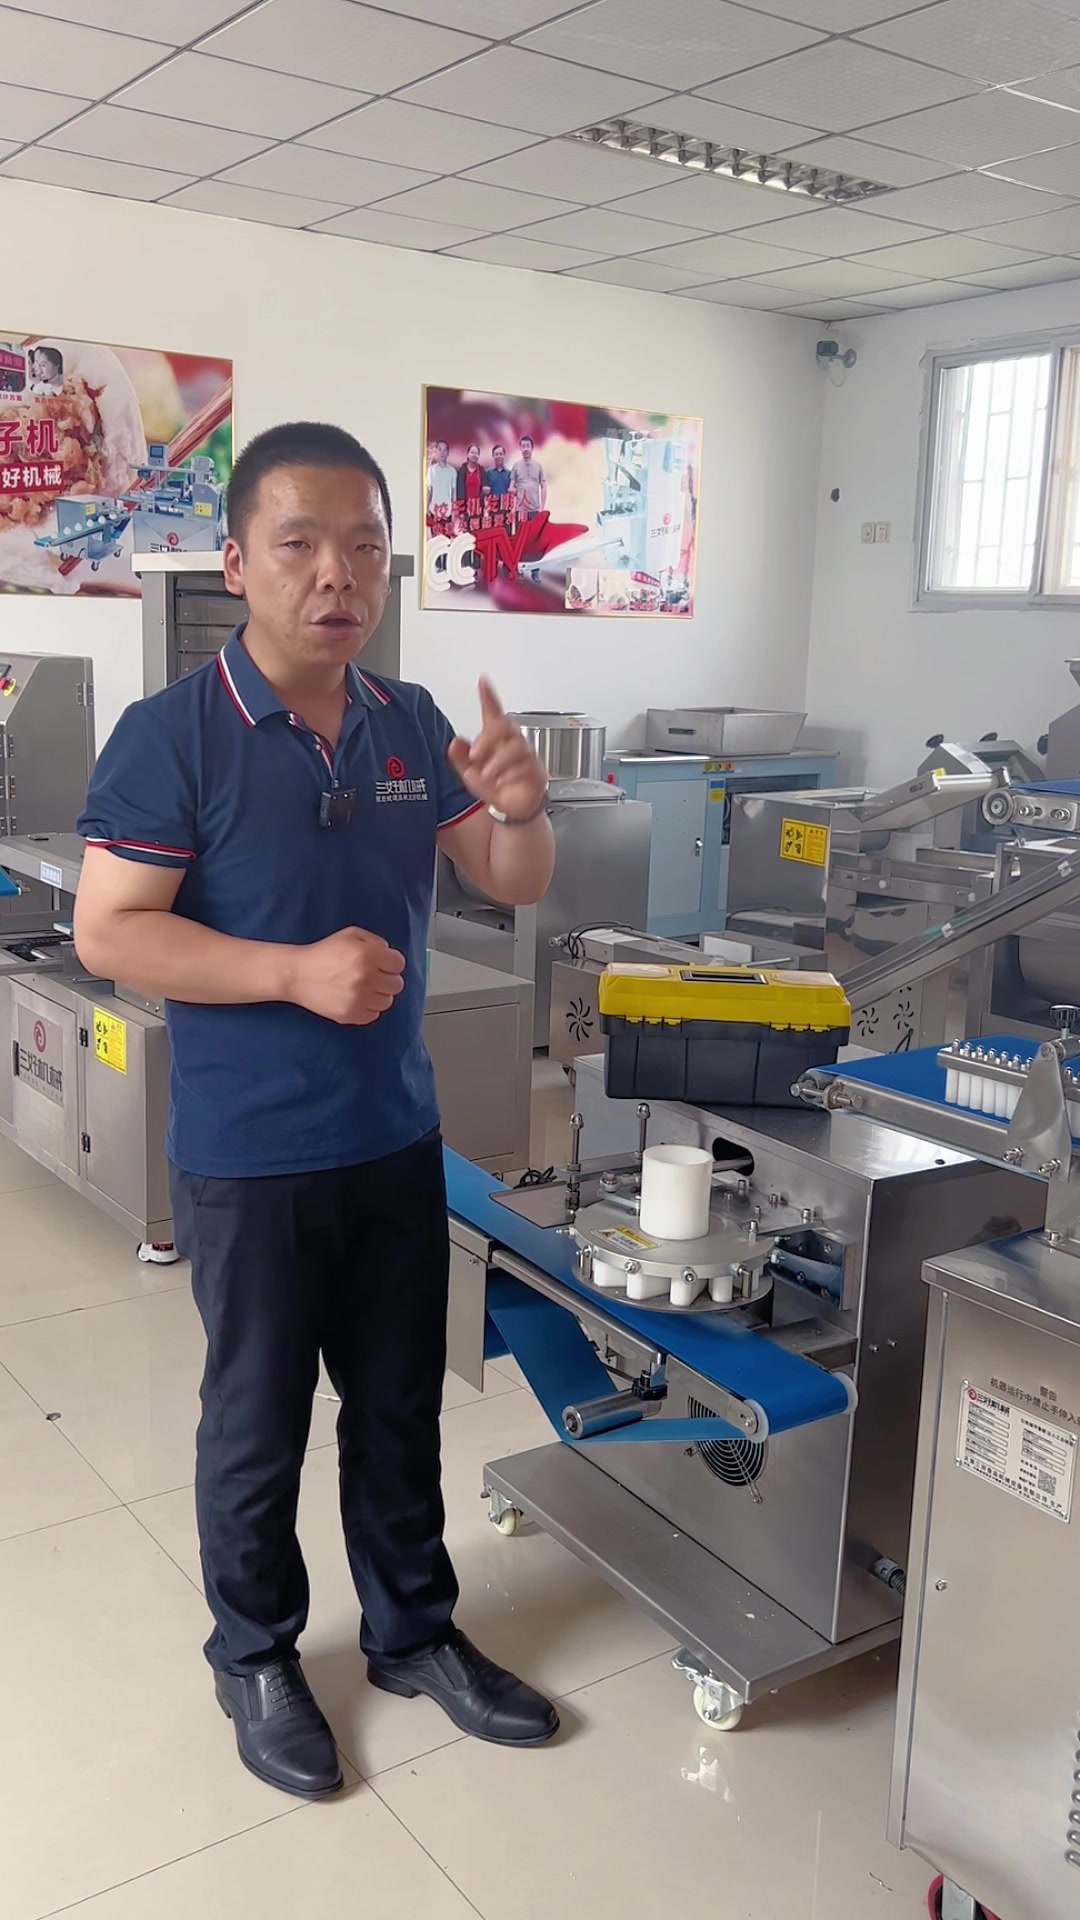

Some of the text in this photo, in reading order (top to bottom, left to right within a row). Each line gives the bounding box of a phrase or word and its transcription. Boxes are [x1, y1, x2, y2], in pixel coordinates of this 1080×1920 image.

[0, 419, 59, 456] 子机
[2, 465, 62, 488] 好机械
[433, 490, 532, 521] 饺子机发明人
[427, 520, 531, 591] CCTV
[1040, 1385, 1057, 1401] 警告
